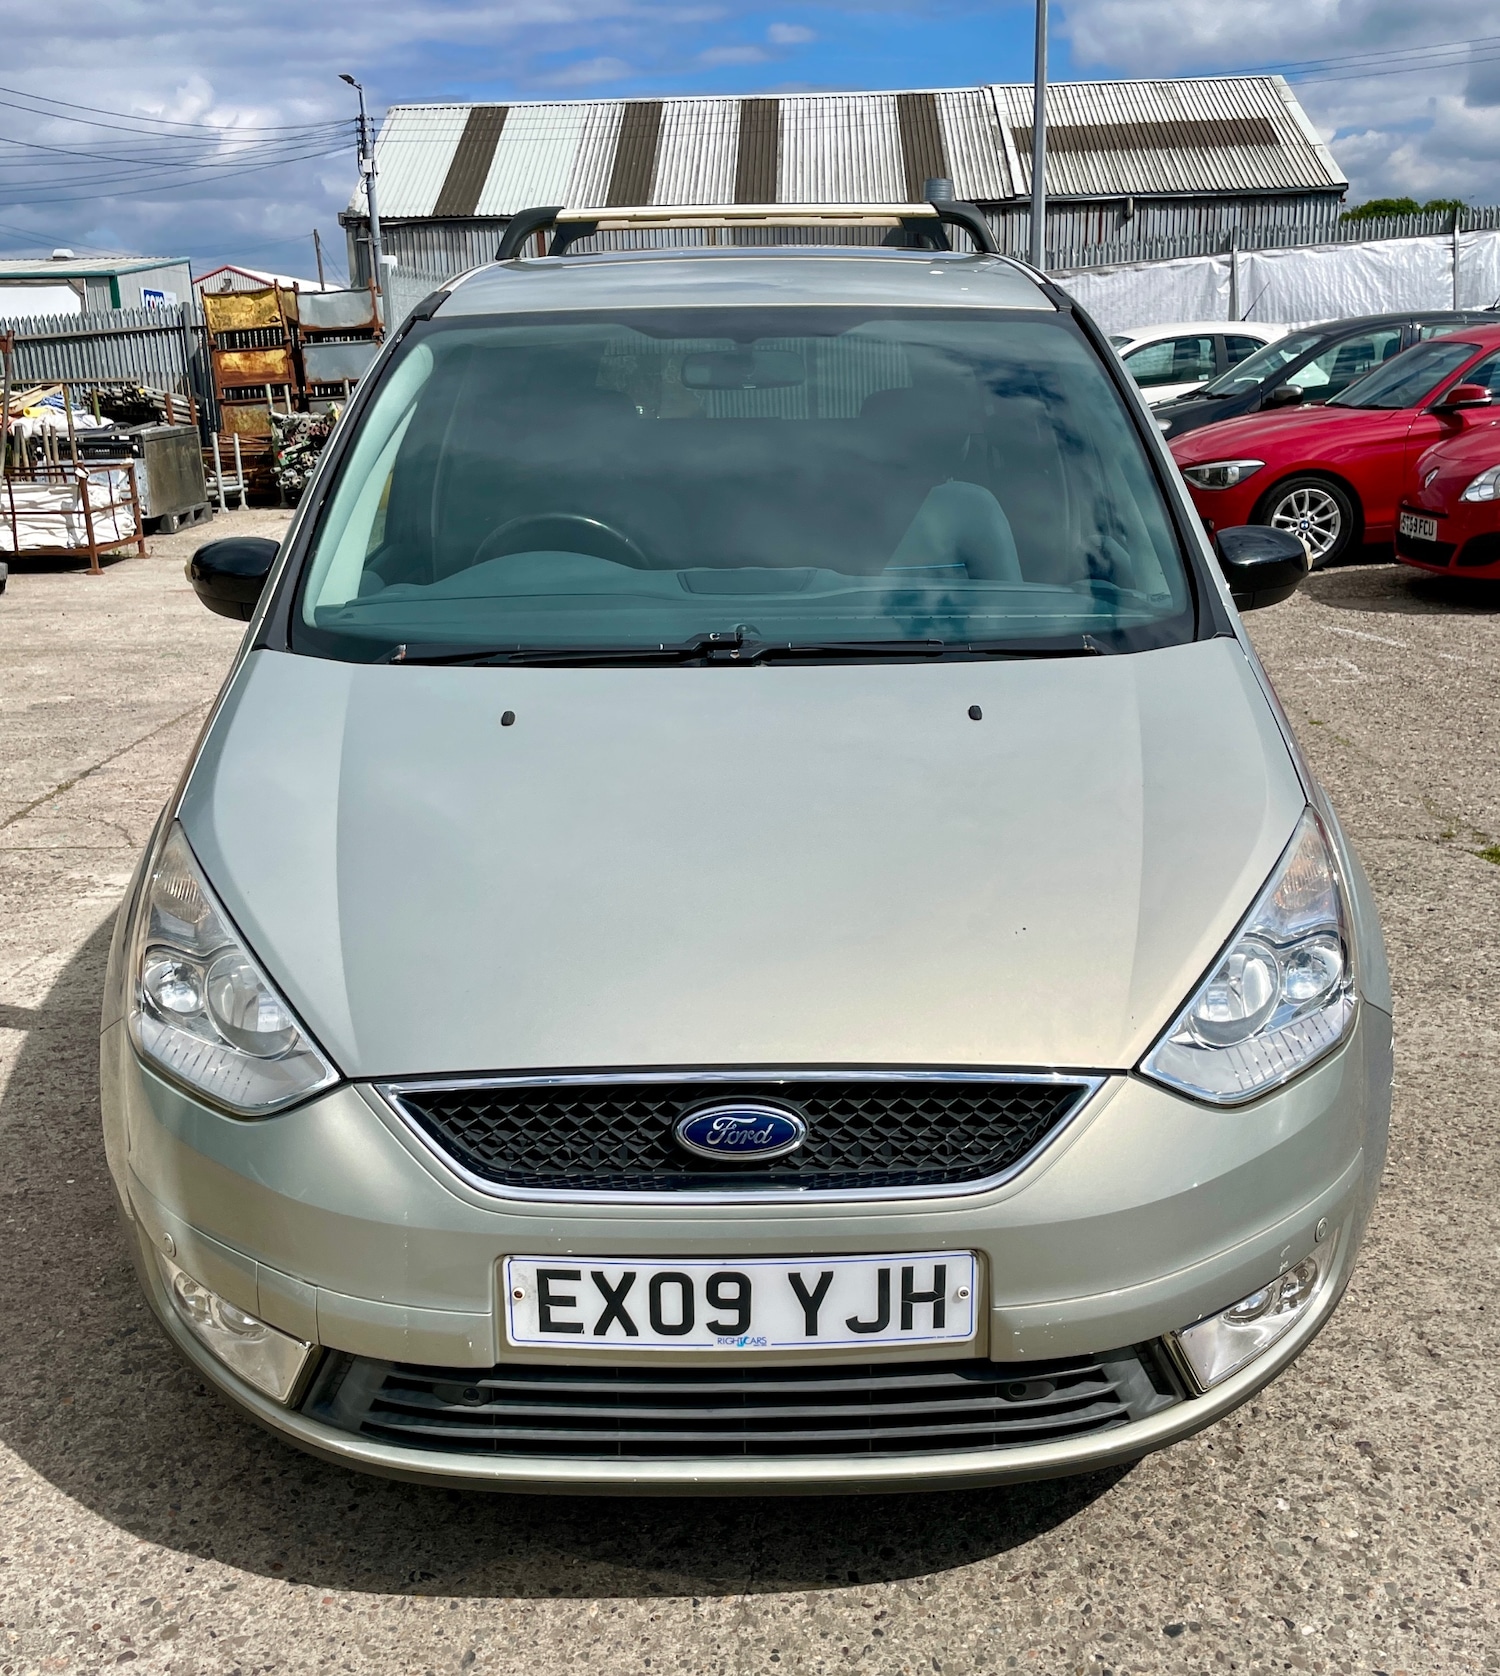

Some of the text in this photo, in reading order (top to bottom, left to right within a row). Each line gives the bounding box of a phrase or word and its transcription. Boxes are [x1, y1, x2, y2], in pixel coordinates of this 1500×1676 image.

[1418, 518, 1434, 536] FCU
[706, 1116, 774, 1145] Ford
[536, 1264, 947, 1336] EX09 YJH
